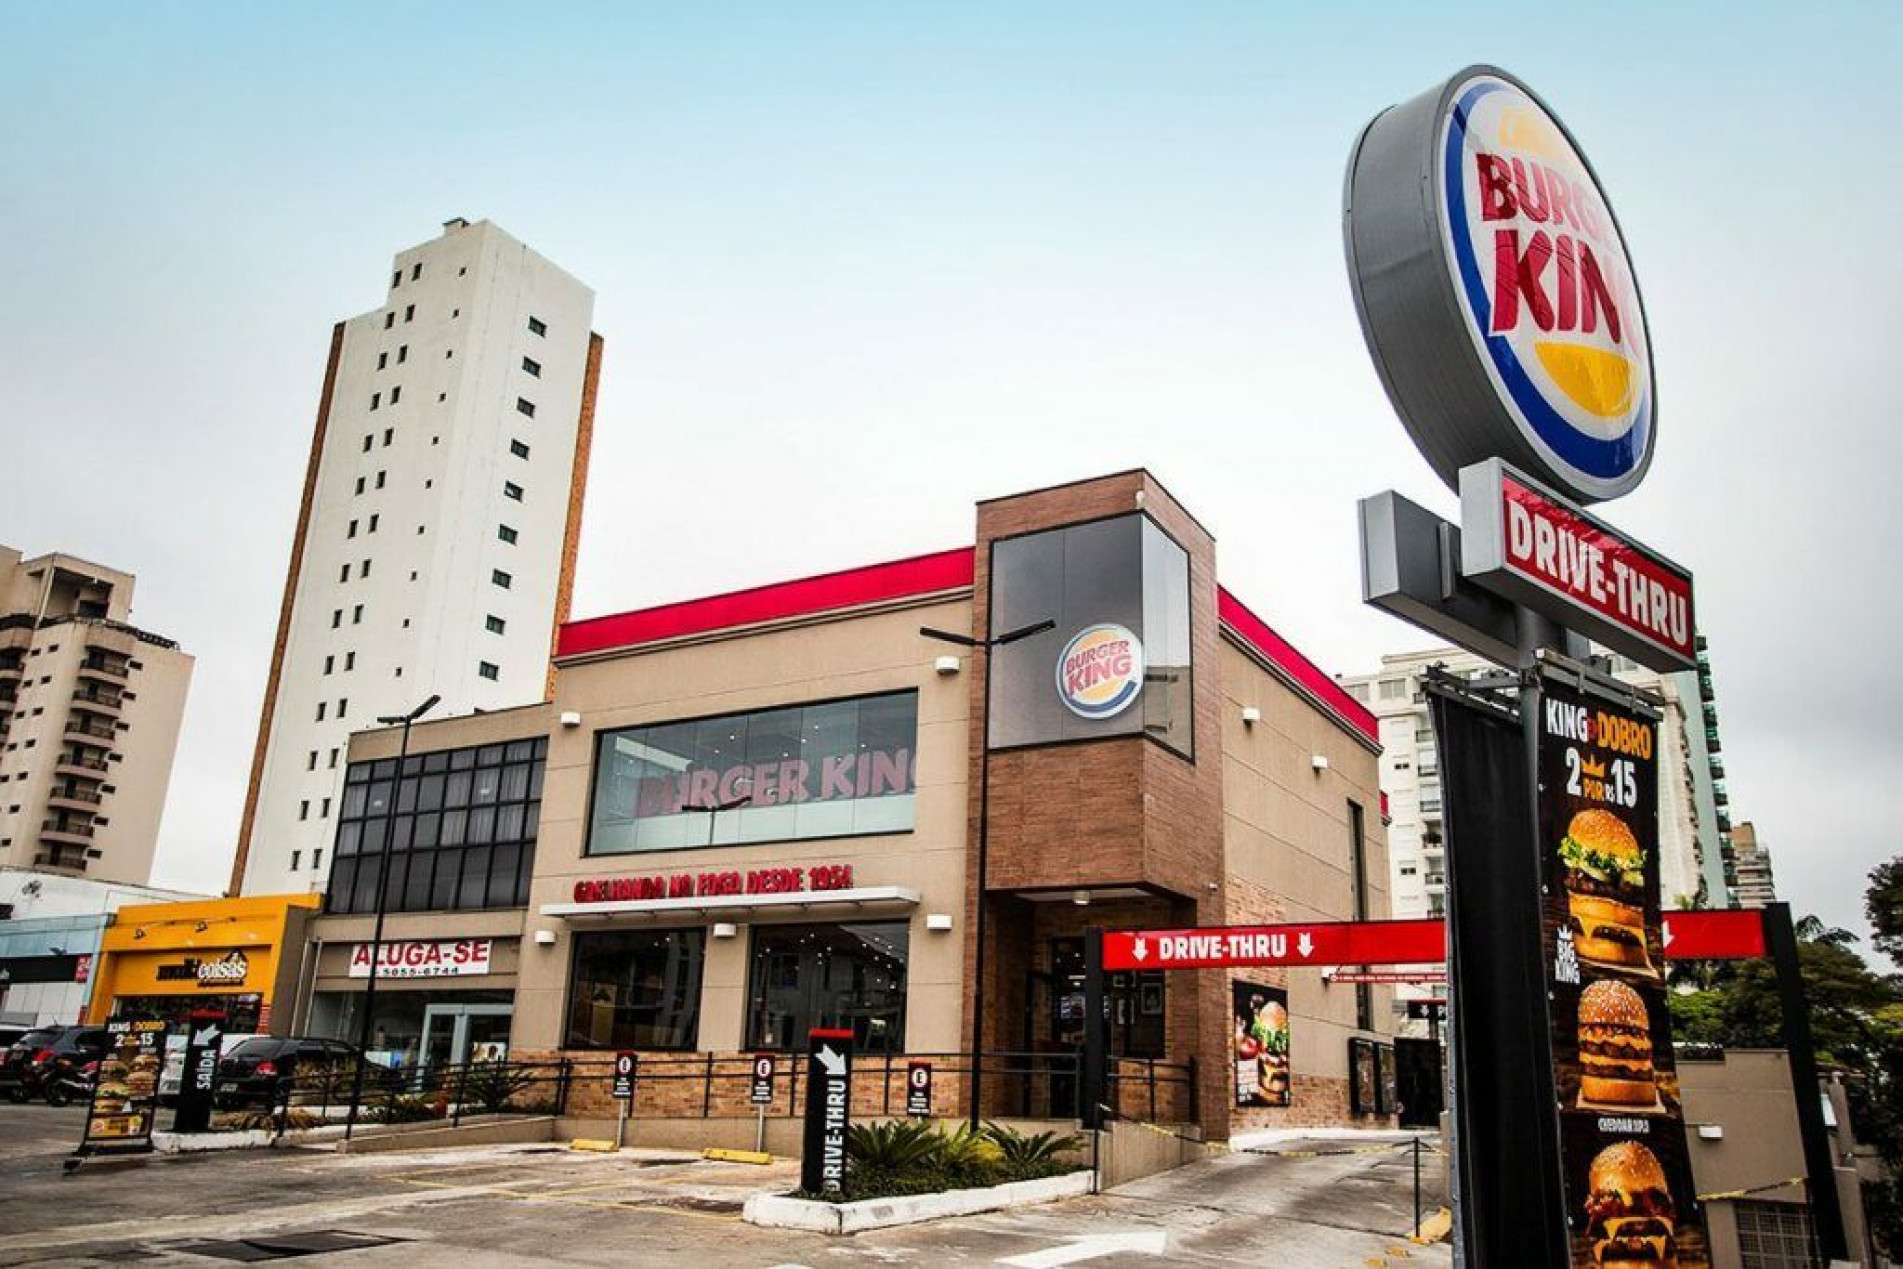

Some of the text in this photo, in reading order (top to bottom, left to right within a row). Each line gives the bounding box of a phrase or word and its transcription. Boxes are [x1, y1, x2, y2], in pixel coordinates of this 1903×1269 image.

[1476, 153, 1604, 242] BURG
[1492, 229, 1630, 350] KIN
[1509, 499, 1687, 646] DRIVE-THRU
[1066, 640, 1130, 676] BURGER
[1068, 655, 1132, 696] KING
[1546, 698, 1589, 742] KING
[1597, 711, 1652, 760] DOBRO
[822, 748, 916, 798] KIN
[1565, 747, 1582, 796] 2
[1611, 758, 1638, 808] 15
[698, 871, 742, 896] FOGO
[747, 868, 804, 894] DESDE
[809, 865, 852, 890] 1954
[1159, 933, 1286, 960] DRIVE-THRU
[821, 1078, 847, 1192] DRIVE-THRU
